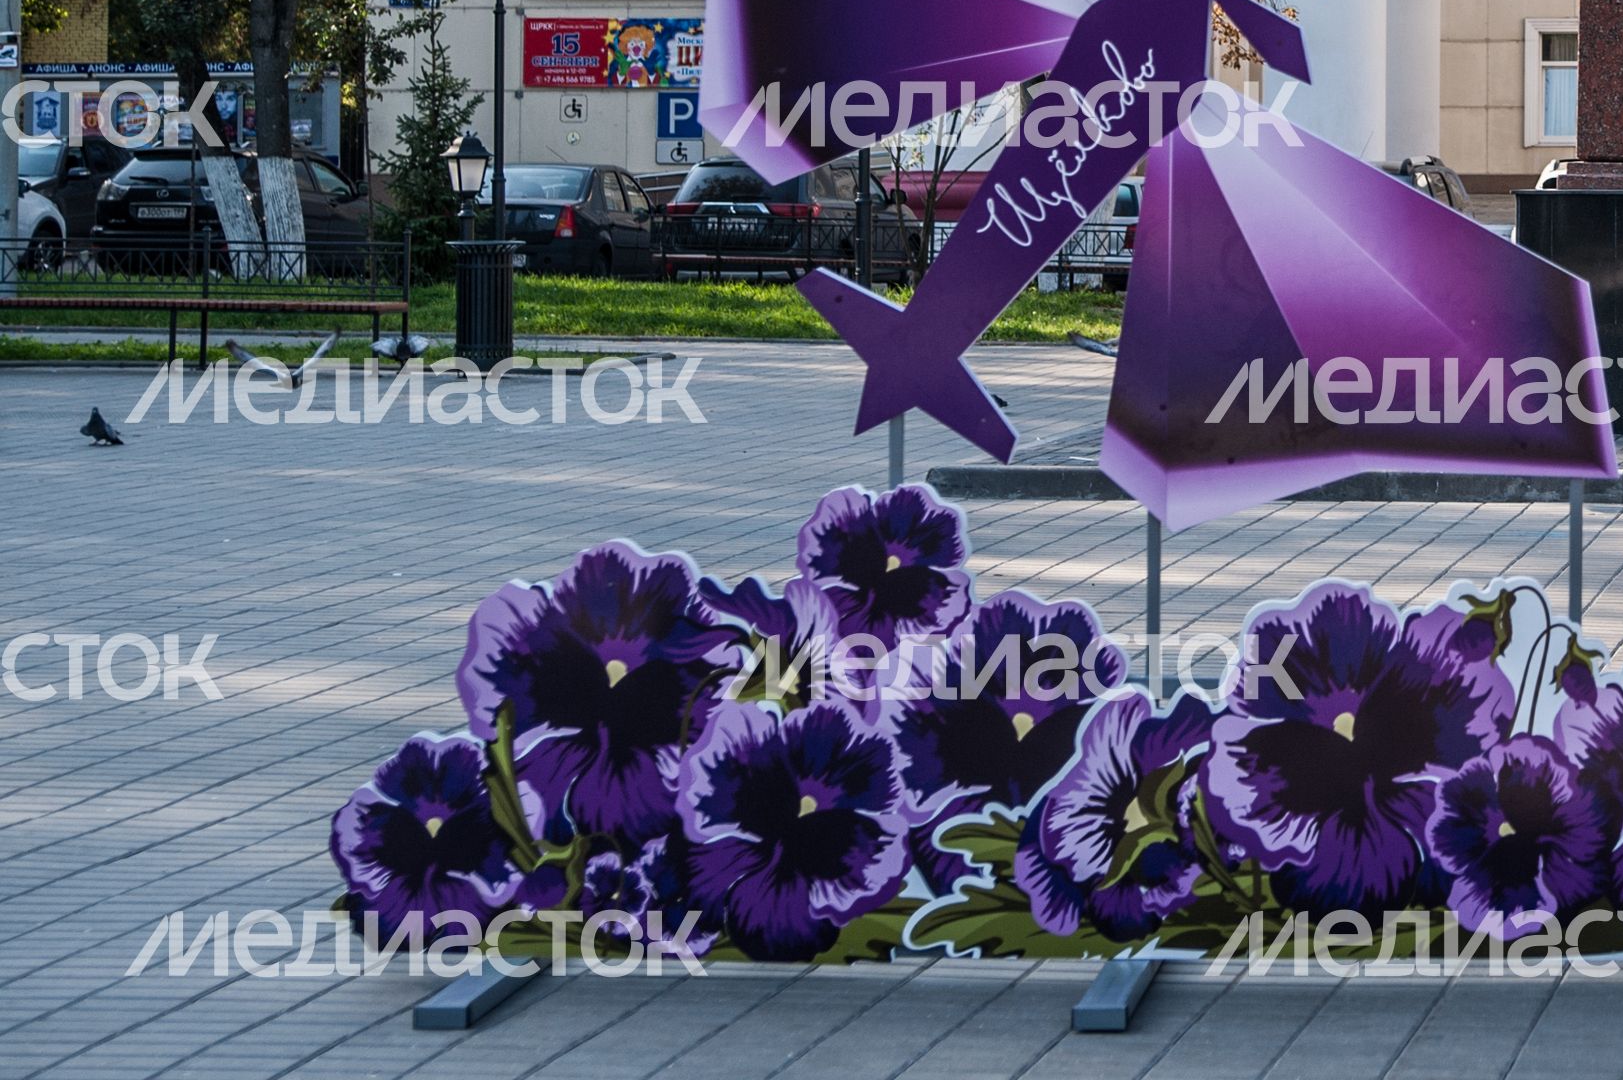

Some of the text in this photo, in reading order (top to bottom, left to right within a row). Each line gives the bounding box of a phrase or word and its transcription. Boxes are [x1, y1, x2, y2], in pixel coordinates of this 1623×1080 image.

[530, 22, 553, 31] ЩРКК
[551, 32, 580, 56] 15
[531, 56, 600, 68] СЕНТЯБРЯ
[36, 63, 78, 73] АФИША
[87, 63, 126, 73] АНОНС
